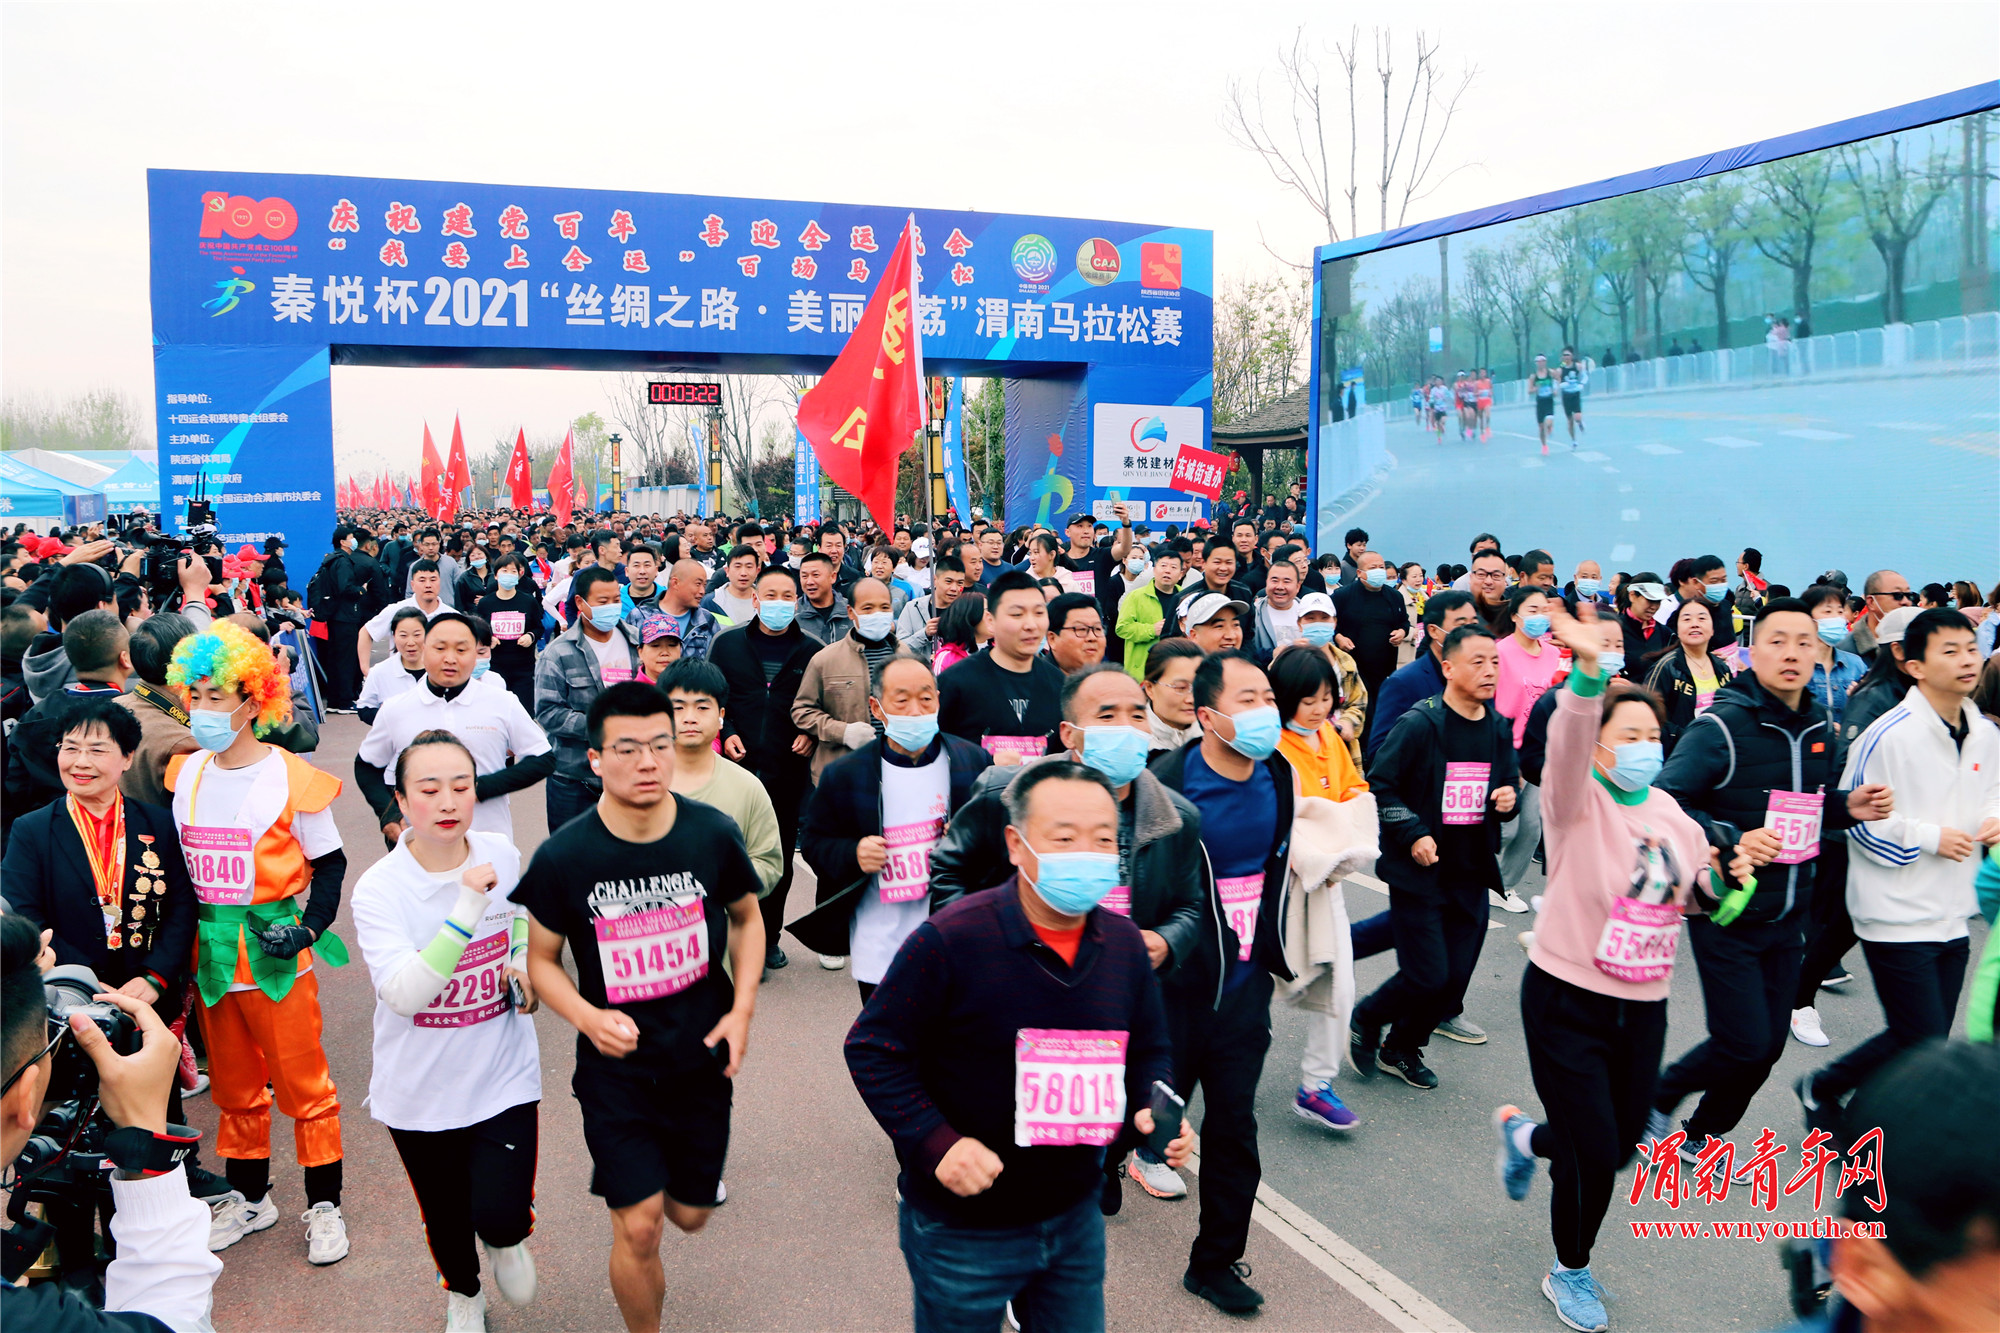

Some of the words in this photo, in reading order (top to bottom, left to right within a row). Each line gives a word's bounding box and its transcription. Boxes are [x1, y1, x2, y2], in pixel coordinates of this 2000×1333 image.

[328, 198, 637, 244] 庆祝建党百年
[737, 254, 974, 287] 百场马松
[1093, 257, 1117, 268] CAA
[651, 384, 719, 403] 00:03:22
[170, 454, 231, 464] 陕西省体育局
[1123, 456, 1174, 469] 秦悦建材
[1175, 456, 1222, 488] 东城街道办
[495, 622, 522, 632] 52719
[185, 851, 245, 884] 51840
[594, 871, 694, 900] CHALLENGE
[612, 932, 701, 979] 51454
[1022, 1072, 1117, 1116] 58014
